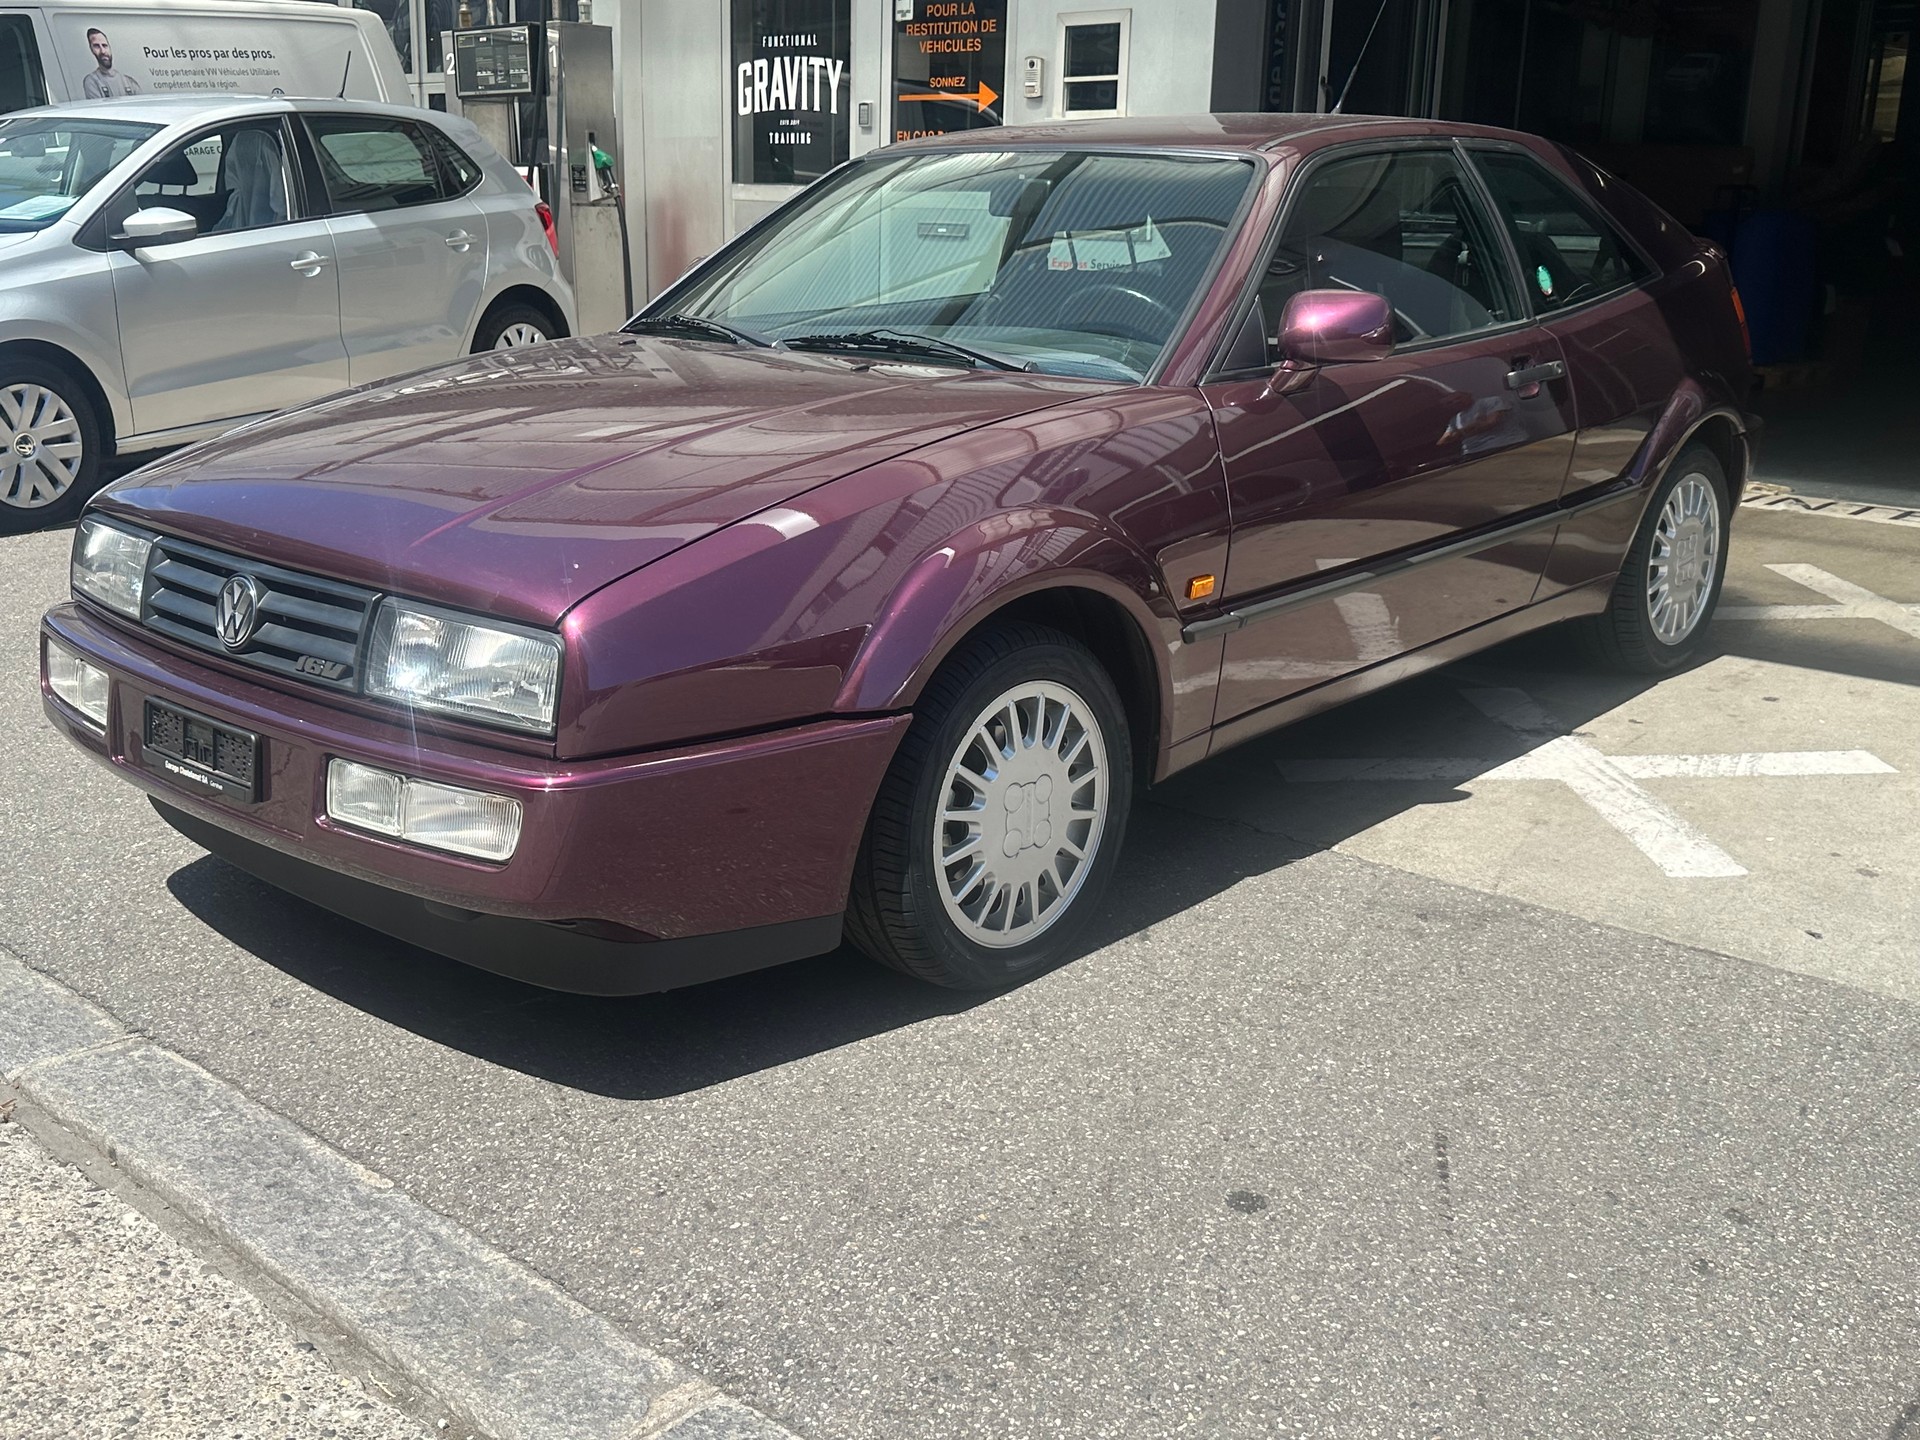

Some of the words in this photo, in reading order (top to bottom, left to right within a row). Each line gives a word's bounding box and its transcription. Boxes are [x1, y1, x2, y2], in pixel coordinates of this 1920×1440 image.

[927, 3, 957, 17] POUR
[961, 2, 976, 15] LA
[906, 21, 978, 36] RESTITUTION
[981, 19, 997, 32] DE
[762, 34, 817, 47] FUNCTIONAL
[920, 38, 982, 53] VEHICULES
[143, 46, 169, 58] Pour
[170, 47, 187, 58] les
[188, 49, 212, 60] pros
[213, 49, 230, 60] par
[232, 47, 250, 59] des
[251, 49, 276, 61] pros.
[549, 45, 557, 68] 1
[445, 52, 456, 75] 2
[150, 68, 169, 76] Votre
[170, 68, 205, 77] partenaire
[205, 68, 217, 76] VW
[218, 67, 249, 76] Véhicules
[250, 68, 280, 76] Utilitaires
[153, 80, 191, 90] compétent
[192, 80, 208, 89] dans
[209, 80, 215, 88] la
[738, 56, 844, 116] GRAVITY
[929, 77, 966, 88] SONNEZ
[769, 132, 811, 144] TRAINING
[896, 130, 911, 143] EN
[1051, 257, 1088, 270] Exprss
[296, 655, 347, 680] 16V
